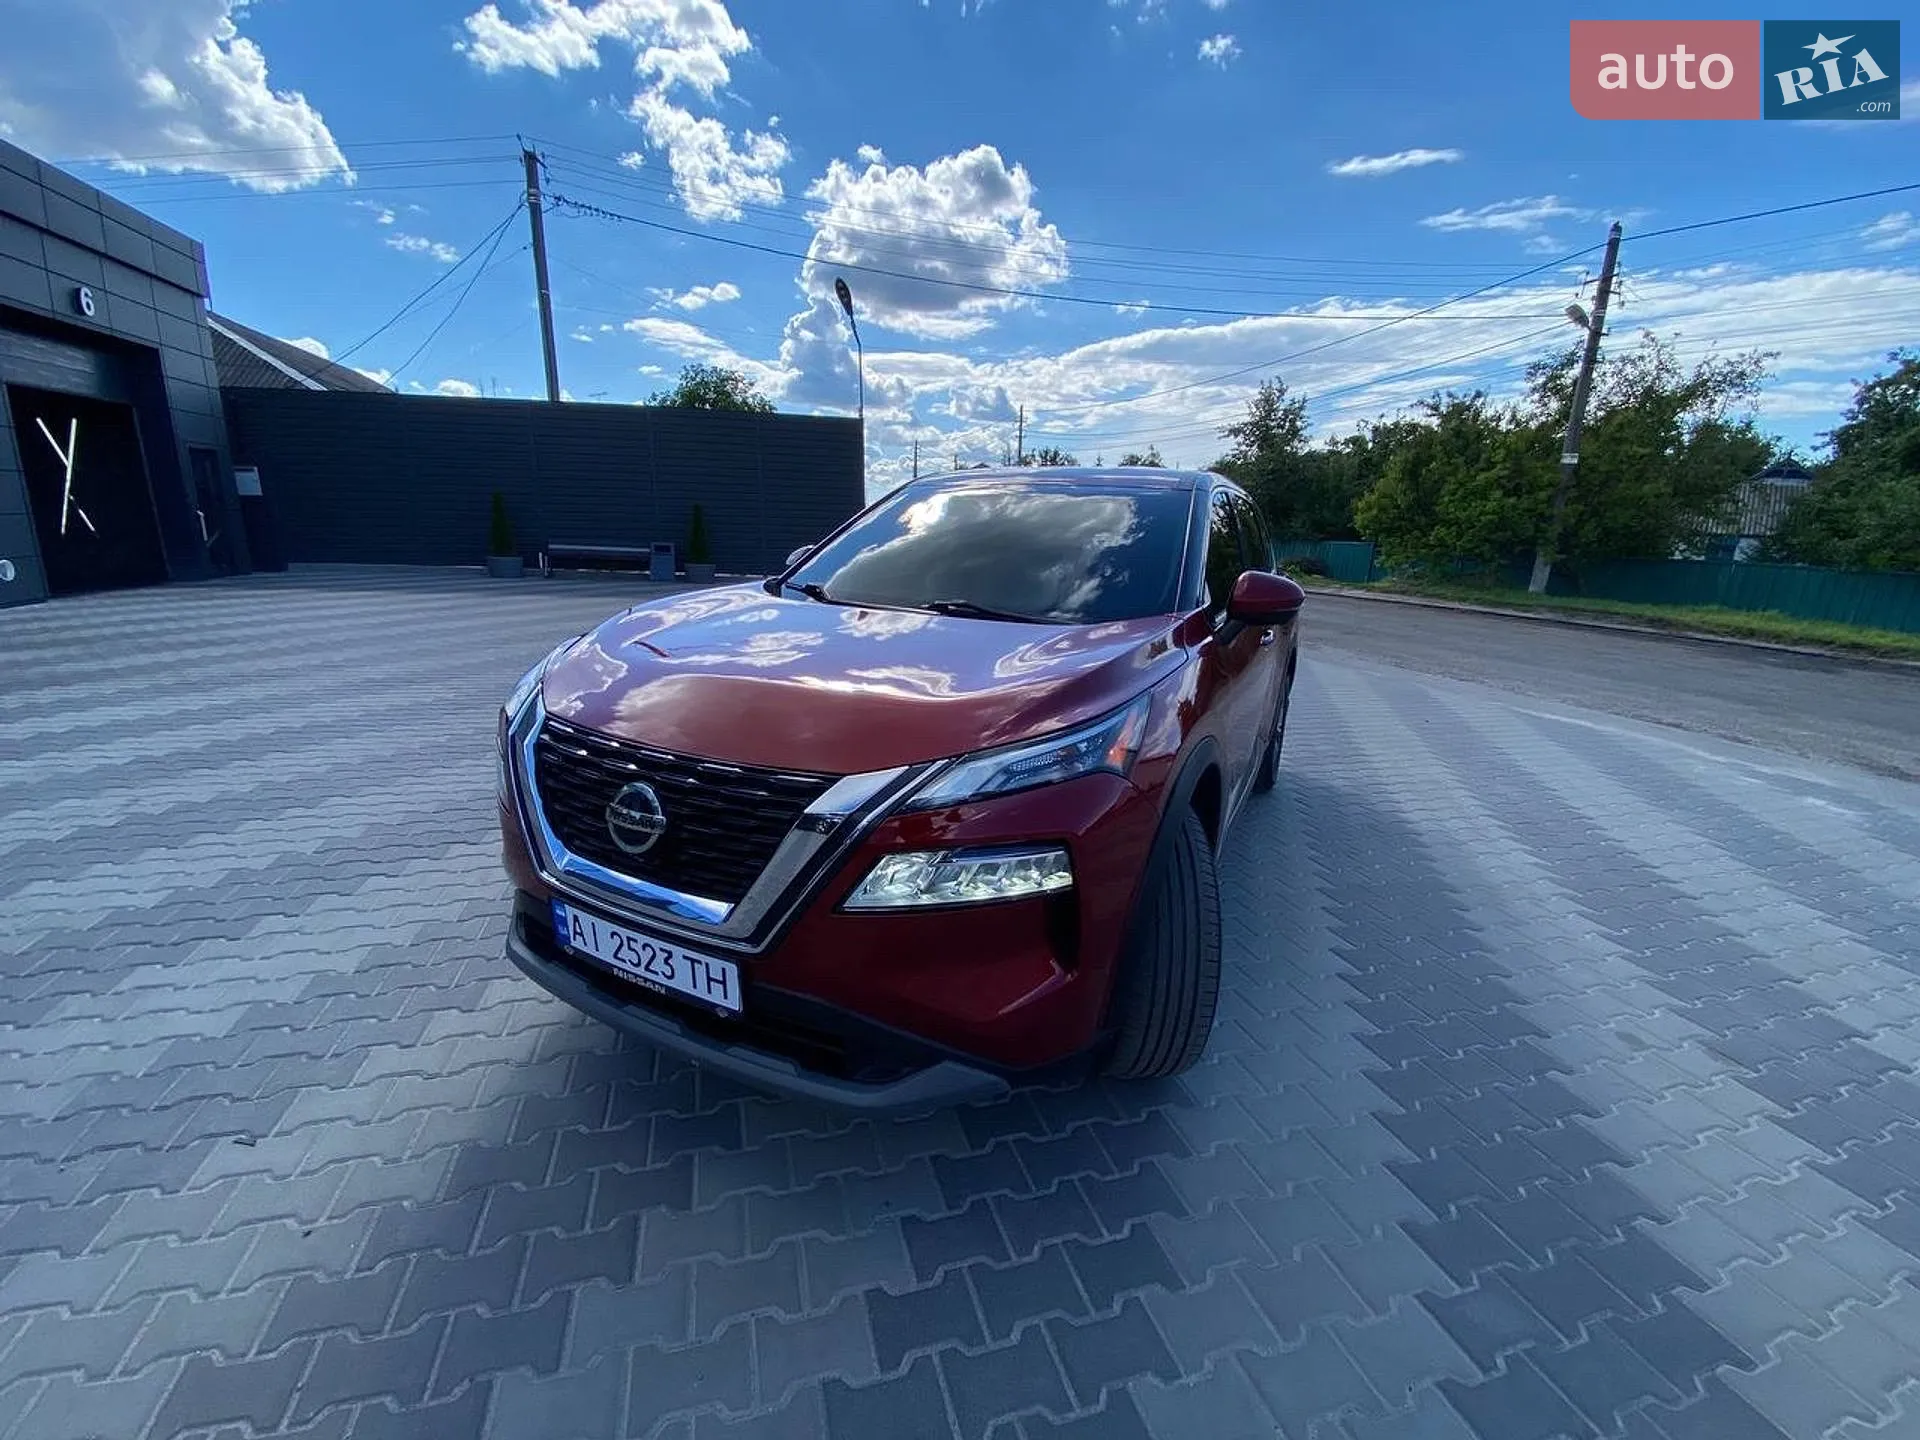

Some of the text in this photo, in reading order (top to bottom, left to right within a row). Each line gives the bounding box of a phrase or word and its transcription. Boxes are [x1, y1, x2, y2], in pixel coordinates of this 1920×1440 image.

[80, 286, 95, 317] 6
[572, 914, 728, 1000] AI 2523 TH
